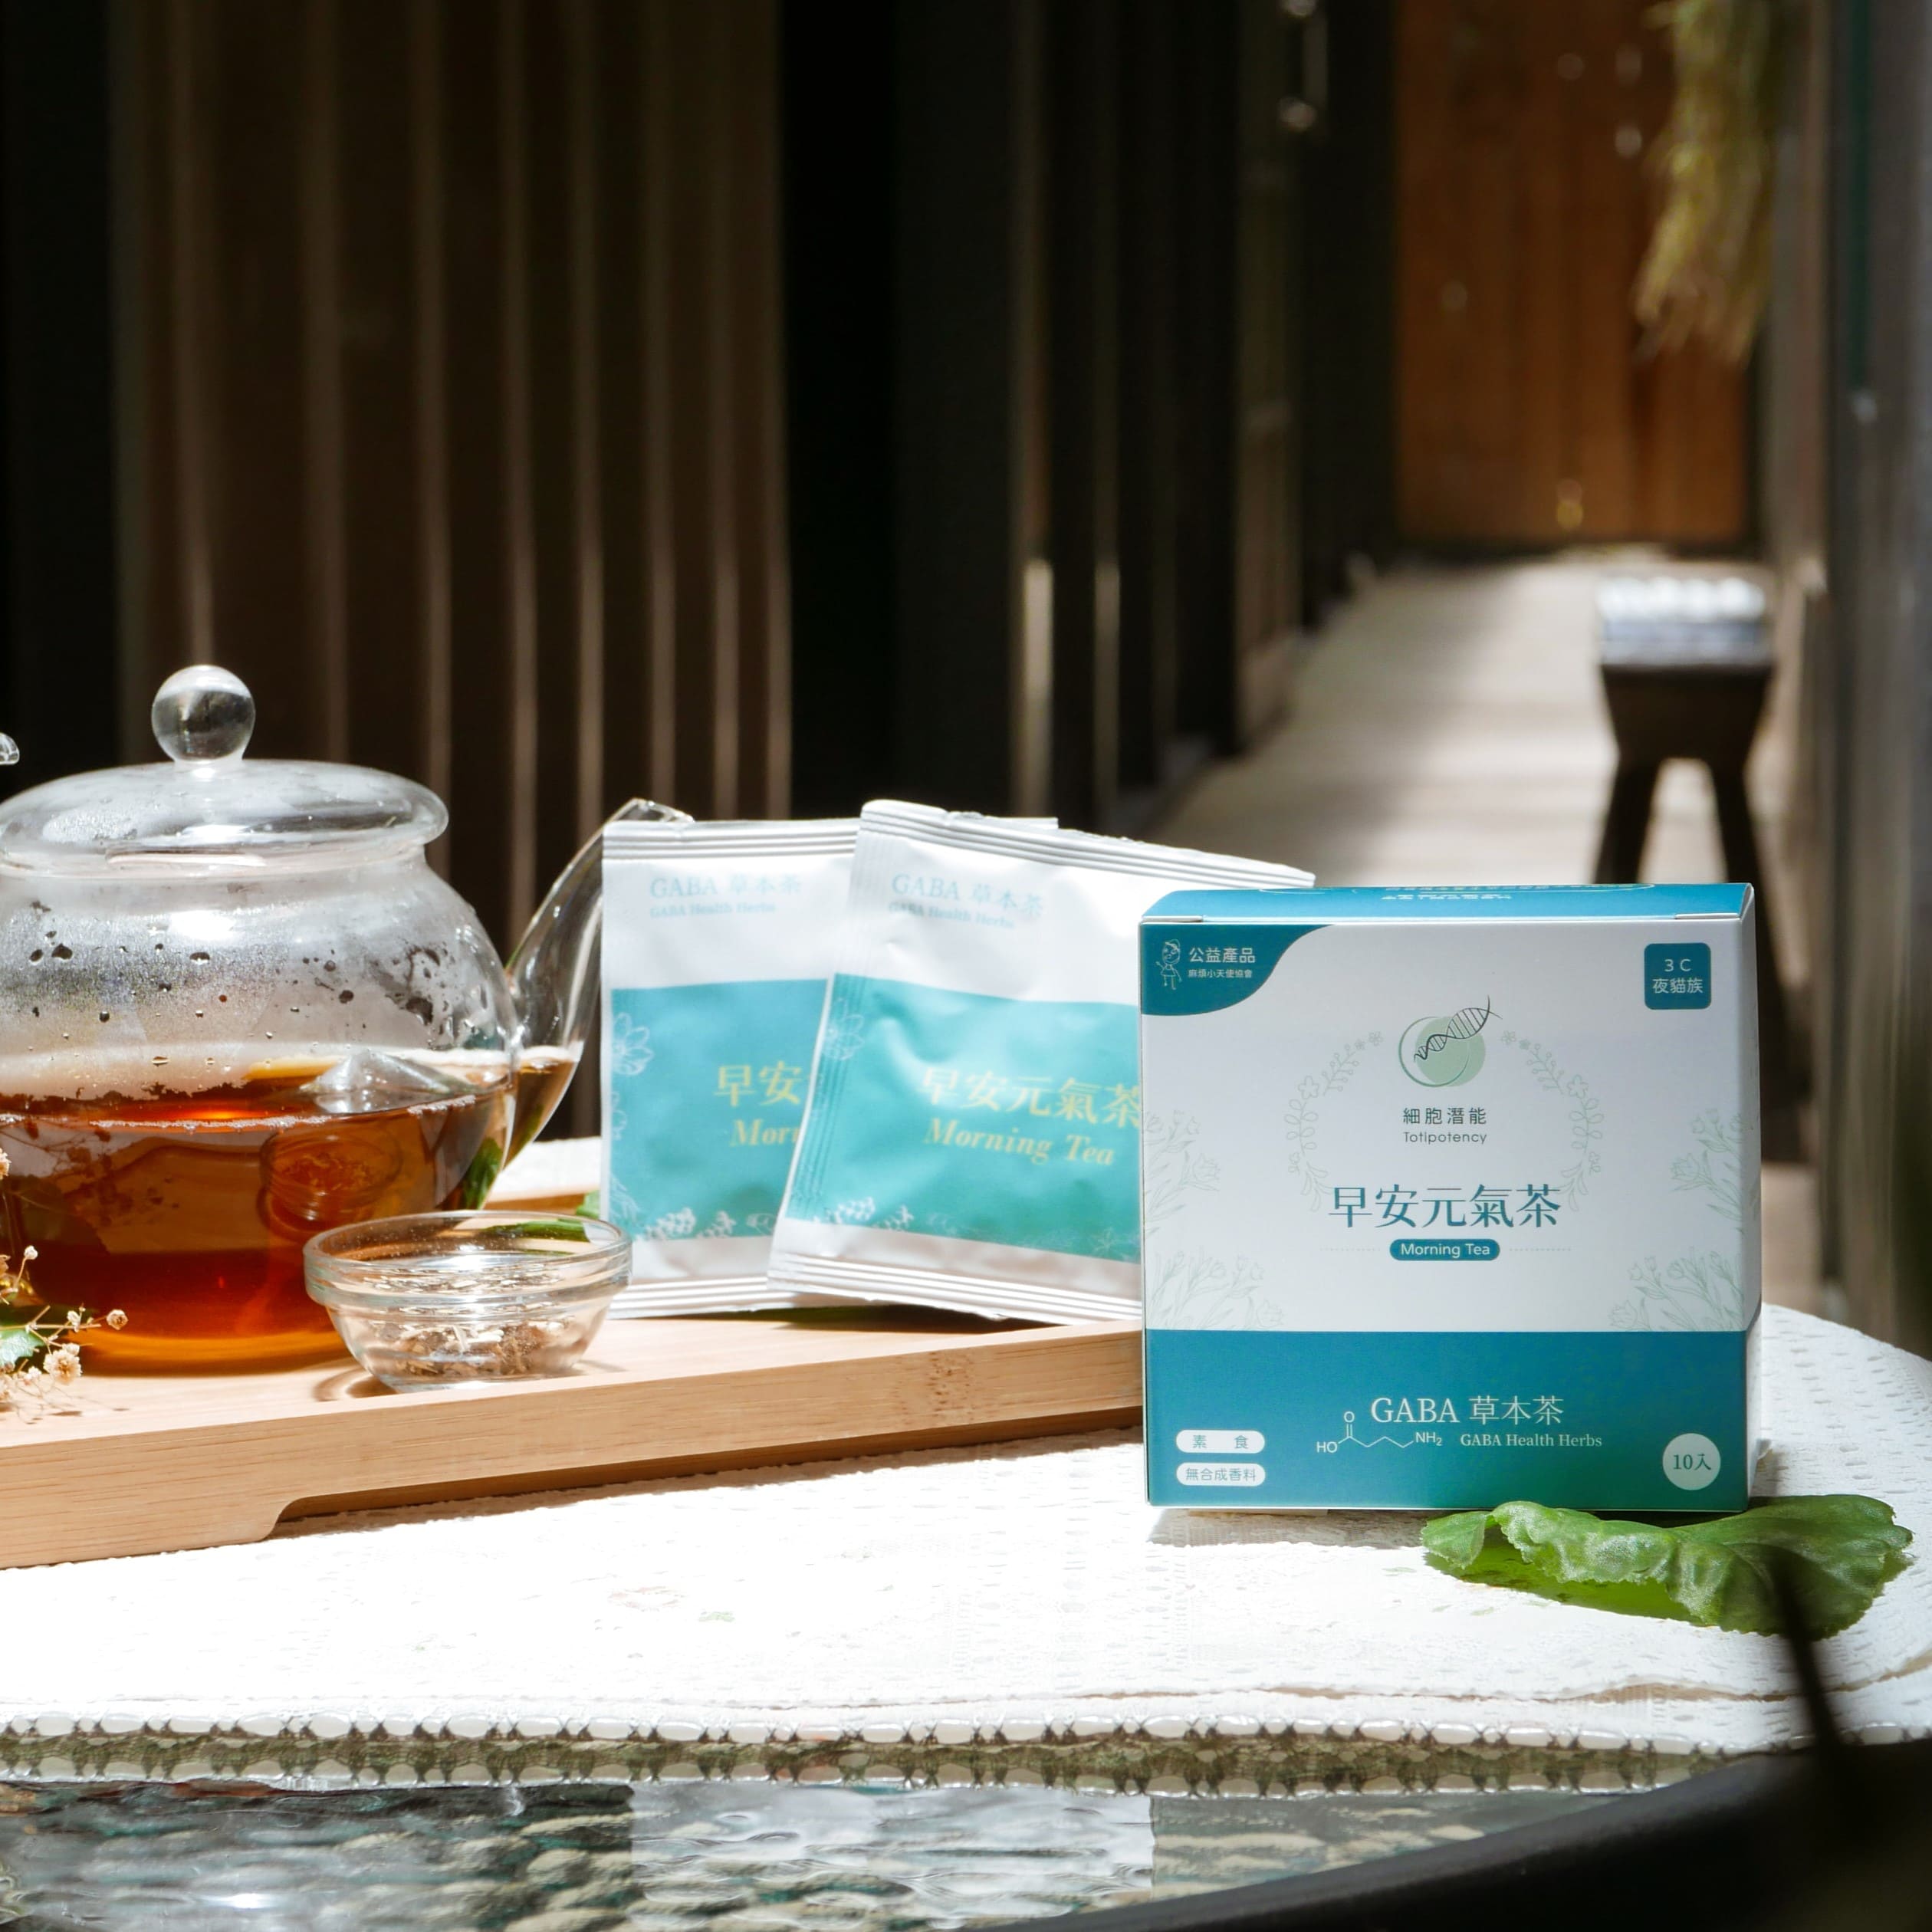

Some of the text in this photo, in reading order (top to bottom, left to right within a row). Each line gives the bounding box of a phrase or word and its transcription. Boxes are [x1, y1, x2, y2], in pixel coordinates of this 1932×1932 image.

[650, 876, 718, 899] GABA
[892, 873, 1042, 918] GABA 草本茶
[1189, 947, 1256, 963] 公益產品
[1652, 978, 1704, 994] 夜貓族
[714, 1060, 801, 1107] 早安
[922, 1066, 1140, 1129] 早安元氣茶
[1402, 1107, 1487, 1125] 細胞潛能
[923, 1117, 1115, 1165] Morning Tea
[1403, 1132, 1487, 1145] Totipotency
[1328, 1184, 1562, 1228] 早安元氣茶
[1401, 1243, 1490, 1258] Morning Tea
[1371, 1395, 1564, 1426] GABA 草本茶
[1316, 1441, 1338, 1453] HO
[1460, 1433, 1602, 1447] GABA Health Herbs
[1673, 1453, 1712, 1470] 10入
[1185, 1467, 1256, 1482] 無合成香料
